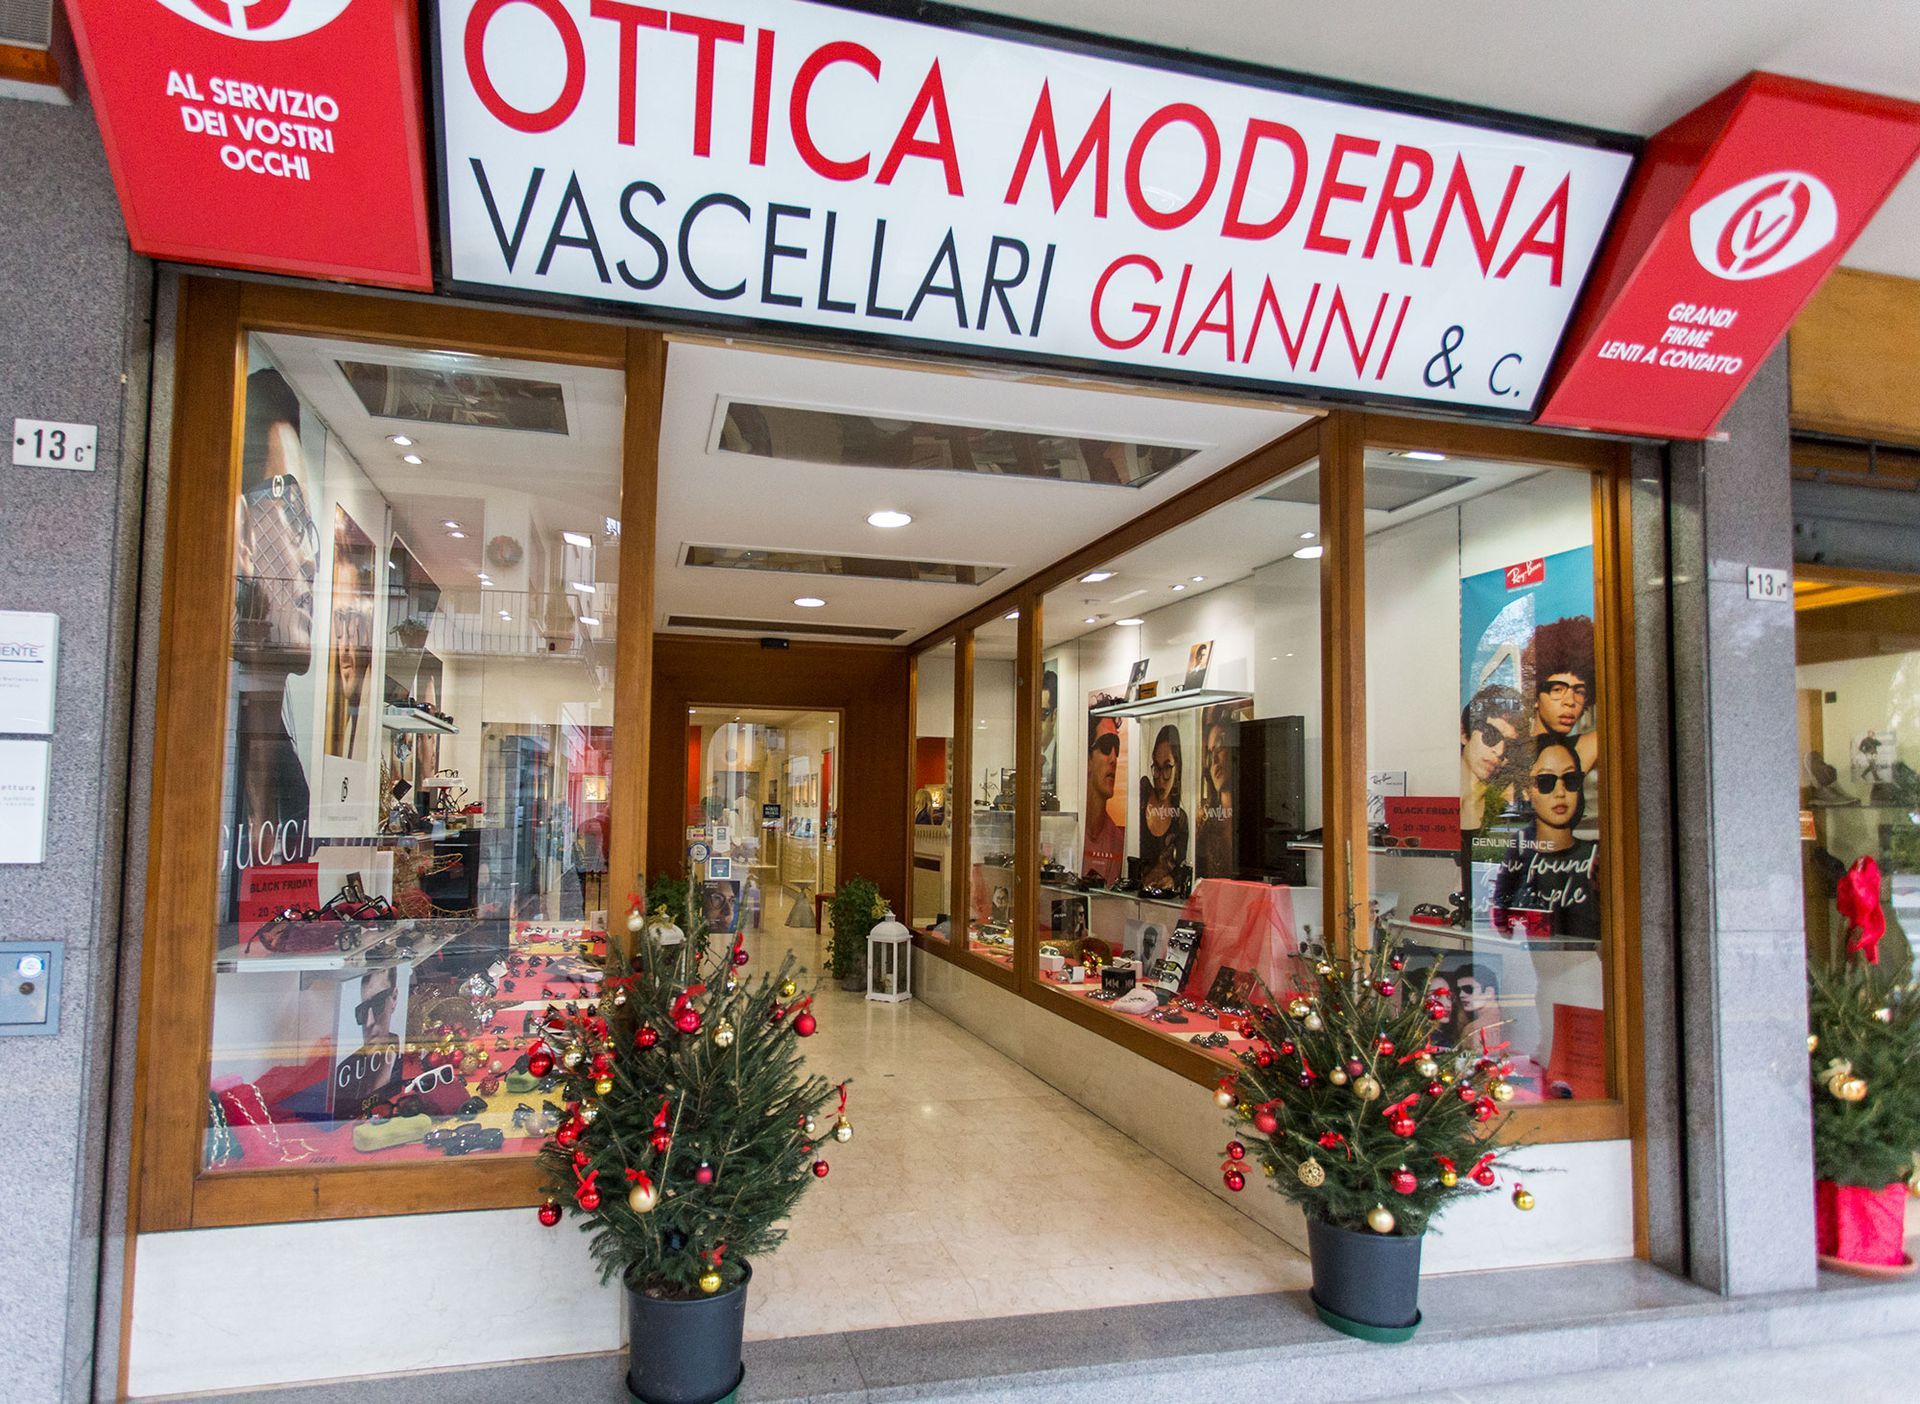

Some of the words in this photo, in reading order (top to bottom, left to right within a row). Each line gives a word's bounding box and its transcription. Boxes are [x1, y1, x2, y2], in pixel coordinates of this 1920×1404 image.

[166, 70, 205, 101] AL
[209, 76, 339, 122] SERVIZIO
[180, 105, 228, 137] DEI
[232, 113, 334, 153] VOSTRI
[464, 0, 965, 197] OTTICA
[1004, 76, 1570, 287] MODERNA
[219, 144, 311, 181] OCCHI
[468, 157, 1056, 337] VASCELLARI
[1091, 253, 1411, 381] GIANNI
[1423, 325, 1463, 389] &
[1667, 301, 1739, 329] GRANDI
[1660, 325, 1713, 349] FIRME
[1597, 340, 1646, 363] LENTI
[1640, 345, 1659, 365] A
[1659, 349, 1743, 375] CONTATTO
[33, 428, 66, 462] 13
[1757, 573, 1774, 596] 13
[1471, 837, 1517, 849] GENUINE
[1518, 839, 1555, 850] SINCE
[250, 880, 280, 893] BLACK
[282, 878, 314, 890] FRIDAY
